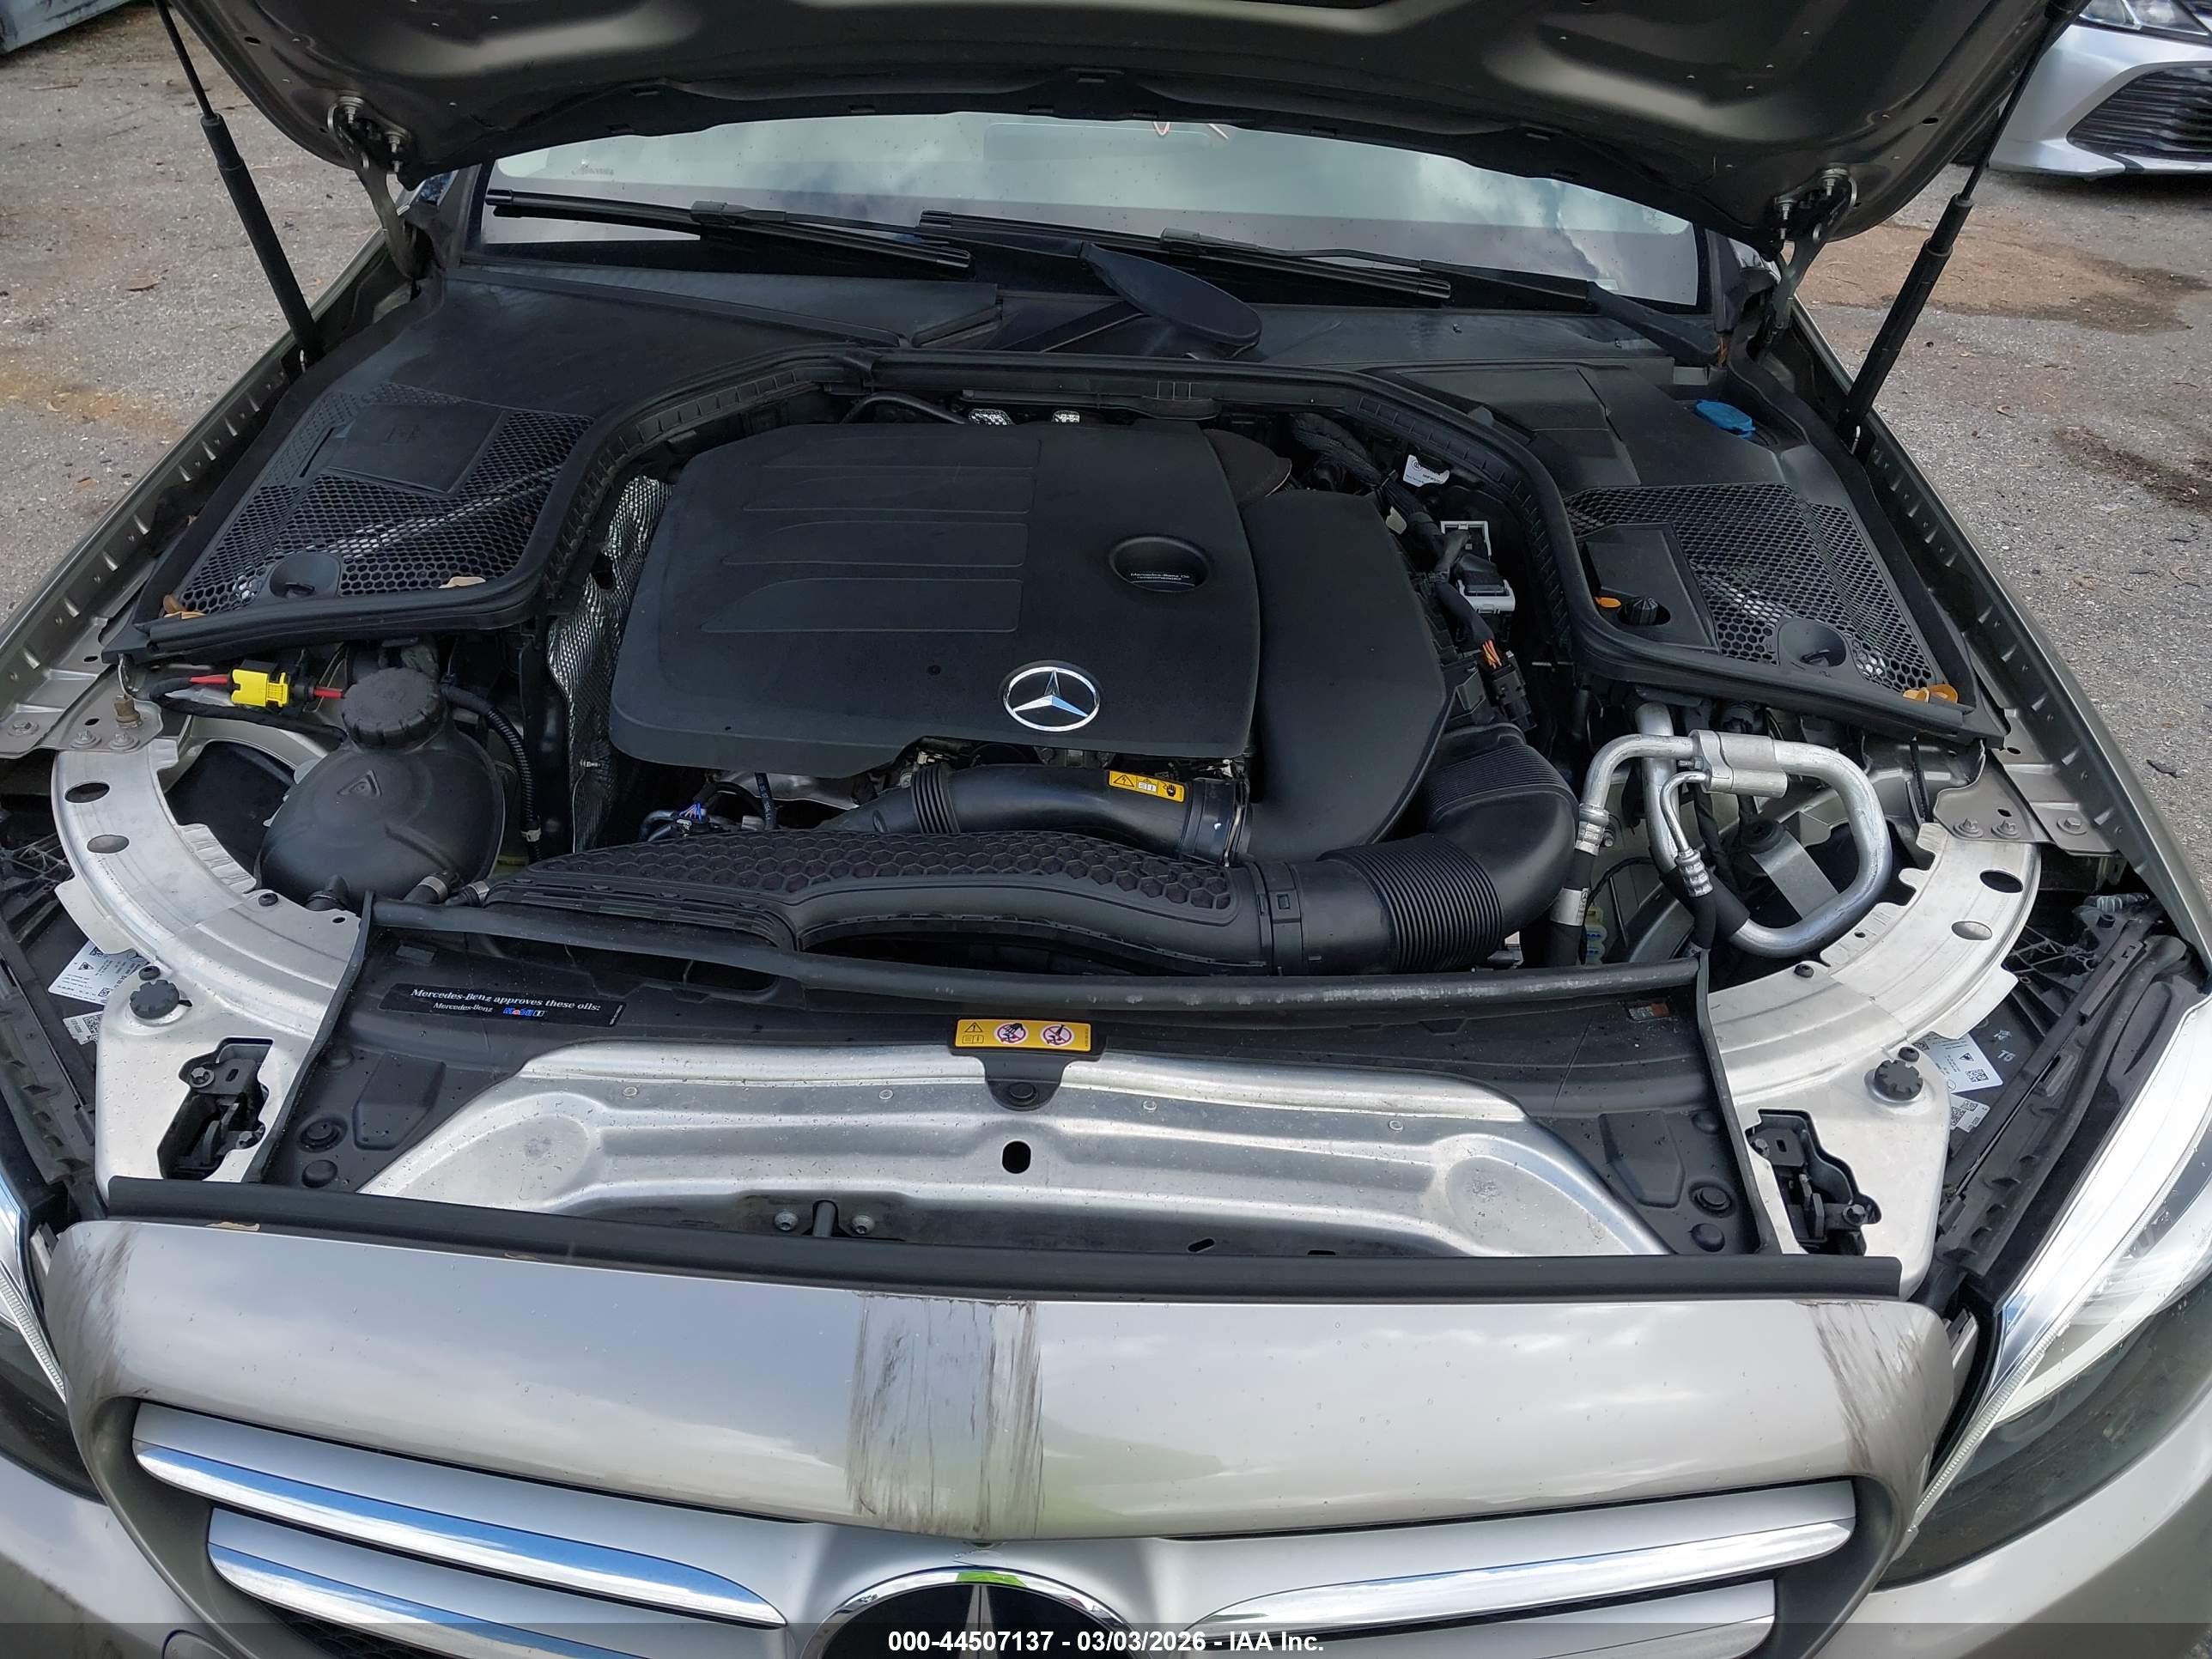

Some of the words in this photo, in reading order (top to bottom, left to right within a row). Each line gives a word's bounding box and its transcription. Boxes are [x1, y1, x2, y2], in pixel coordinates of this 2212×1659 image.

[410, 988, 492, 1003] Mercedes-Benz
[494, 996, 544, 1006] approves
[545, 999, 574, 1009] these
[577, 1002, 601, 1012] oils:
[433, 1002, 493, 1013] Mercedes-Benz
[503, 1007, 532, 1017] Mobil
